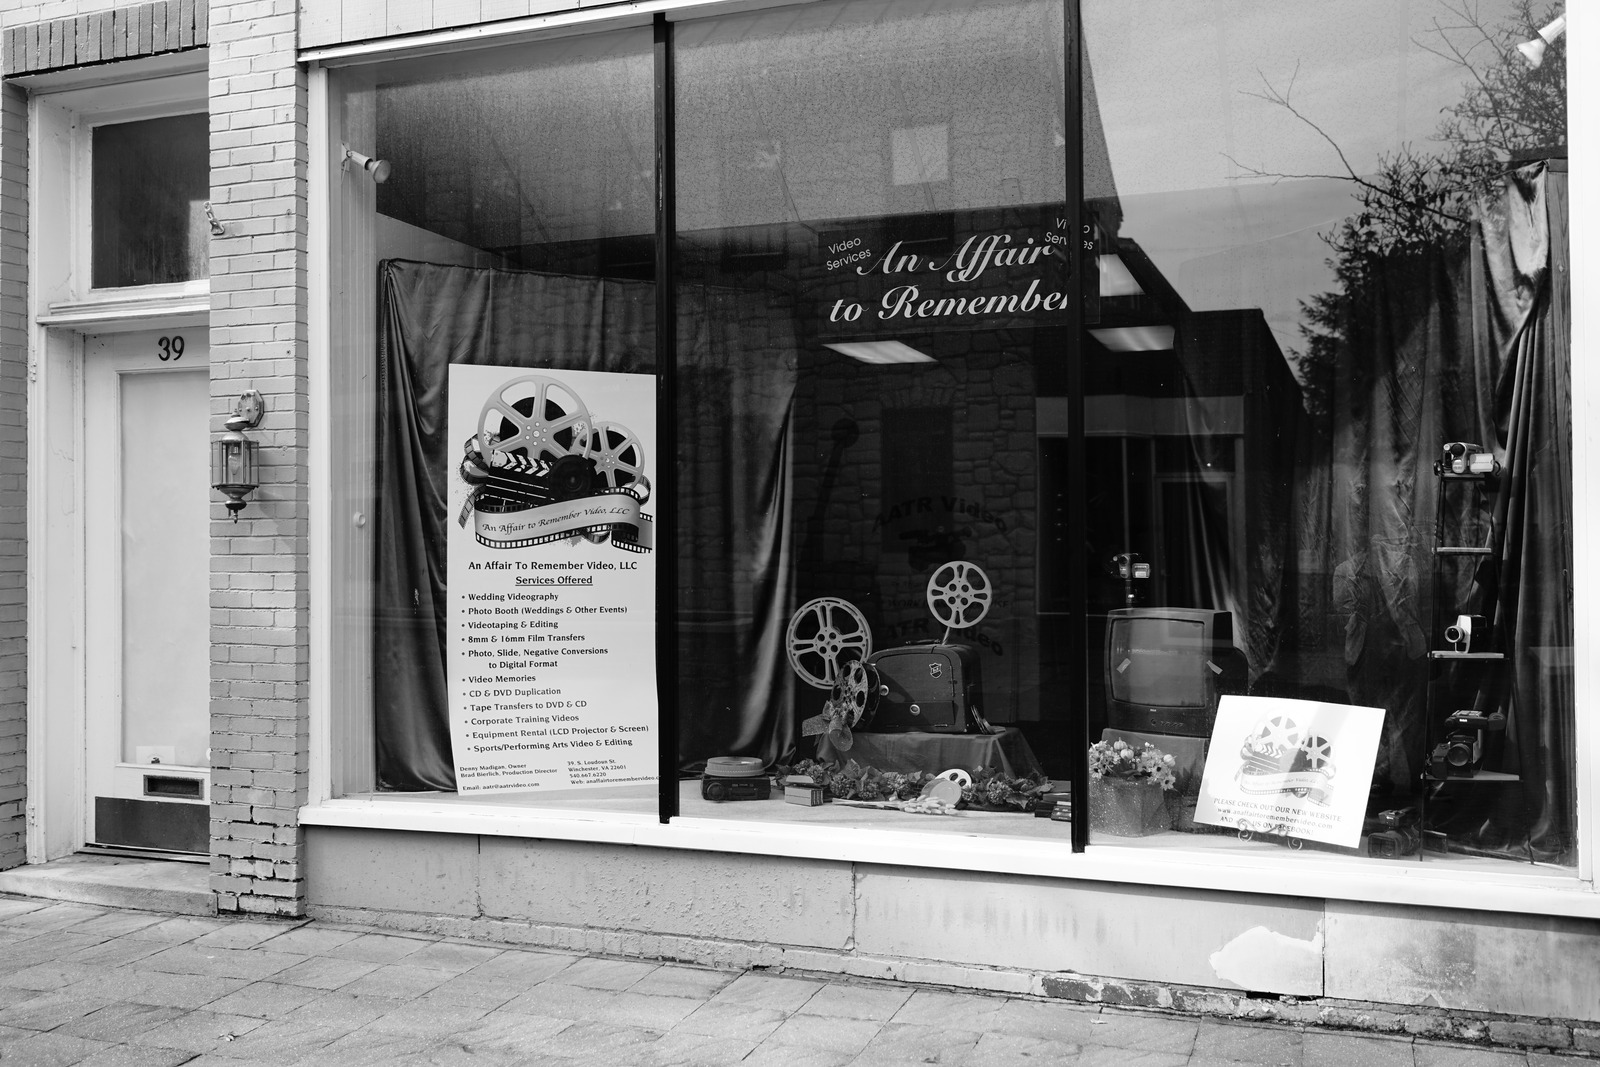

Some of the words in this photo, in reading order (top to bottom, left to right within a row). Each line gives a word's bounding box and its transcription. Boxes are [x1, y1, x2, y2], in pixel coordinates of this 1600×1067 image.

[828, 238, 862, 255] Video
[826, 248, 872, 271] Services
[856, 241, 924, 276] An
[929, 234, 1056, 283] Affair
[829, 299, 869, 323] to
[158, 336, 185, 361] 39
[942, 496, 1007, 532] Video
[482, 523, 497, 532] An
[500, 523, 526, 535] Affair
[528, 522, 536, 530] to
[538, 513, 582, 527] Remember
[584, 507, 607, 517] Video,
[469, 562, 481, 570] An
[484, 561, 513, 570] Affair
[515, 562, 528, 570] To
[531, 562, 584, 570] Remember
[587, 561, 617, 571] Video,
[620, 562, 638, 570] LLC
[515, 576, 555, 585] Services
[558, 576, 593, 585] Offered
[468, 594, 505, 602] Wedding
[507, 593, 559, 601] Videography
[522, 607, 564, 615] (Weddings
[600, 606, 628, 614] Events)
[468, 622, 519, 630] Videotaping
[530, 621, 559, 629] Editing
[547, 634, 585, 642] Transfers
[468, 650, 495, 658] Photo,
[497, 649, 521, 657] Slide,
[524, 648, 559, 657] Negative
[561, 647, 608, 656] Conversions
[500, 661, 527, 670] Digital
[496, 675, 536, 683] Memories
[469, 690, 482, 698] CD
[494, 689, 512, 697] DVD
[515, 688, 561, 697] Duplication
[470, 704, 492, 713] Tape
[494, 703, 533, 711] Transfers
[546, 701, 564, 709] DVD
[471, 717, 513, 726] Corporate
[515, 716, 550, 724] Training
[552, 715, 580, 723] Videos
[473, 730, 518, 740] Equipment
[521, 729, 548, 737] Rental
[550, 728, 570, 736] (LCD
[572, 726, 608, 735] Projector
[619, 725, 649, 733] Screen)
[474, 742, 550, 753] Sports/Performing
[552, 741, 568, 749] Arts
[605, 739, 633, 747] Editing
[1214, 797, 1236, 806] PLEASE
[1238, 801, 1258, 809] CHECK
[1260, 804, 1275, 812] OUT
[1275, 806, 1290, 814] OUR
[1292, 808, 1309, 816] NEW
[1309, 811, 1342, 822] WEBSITE
